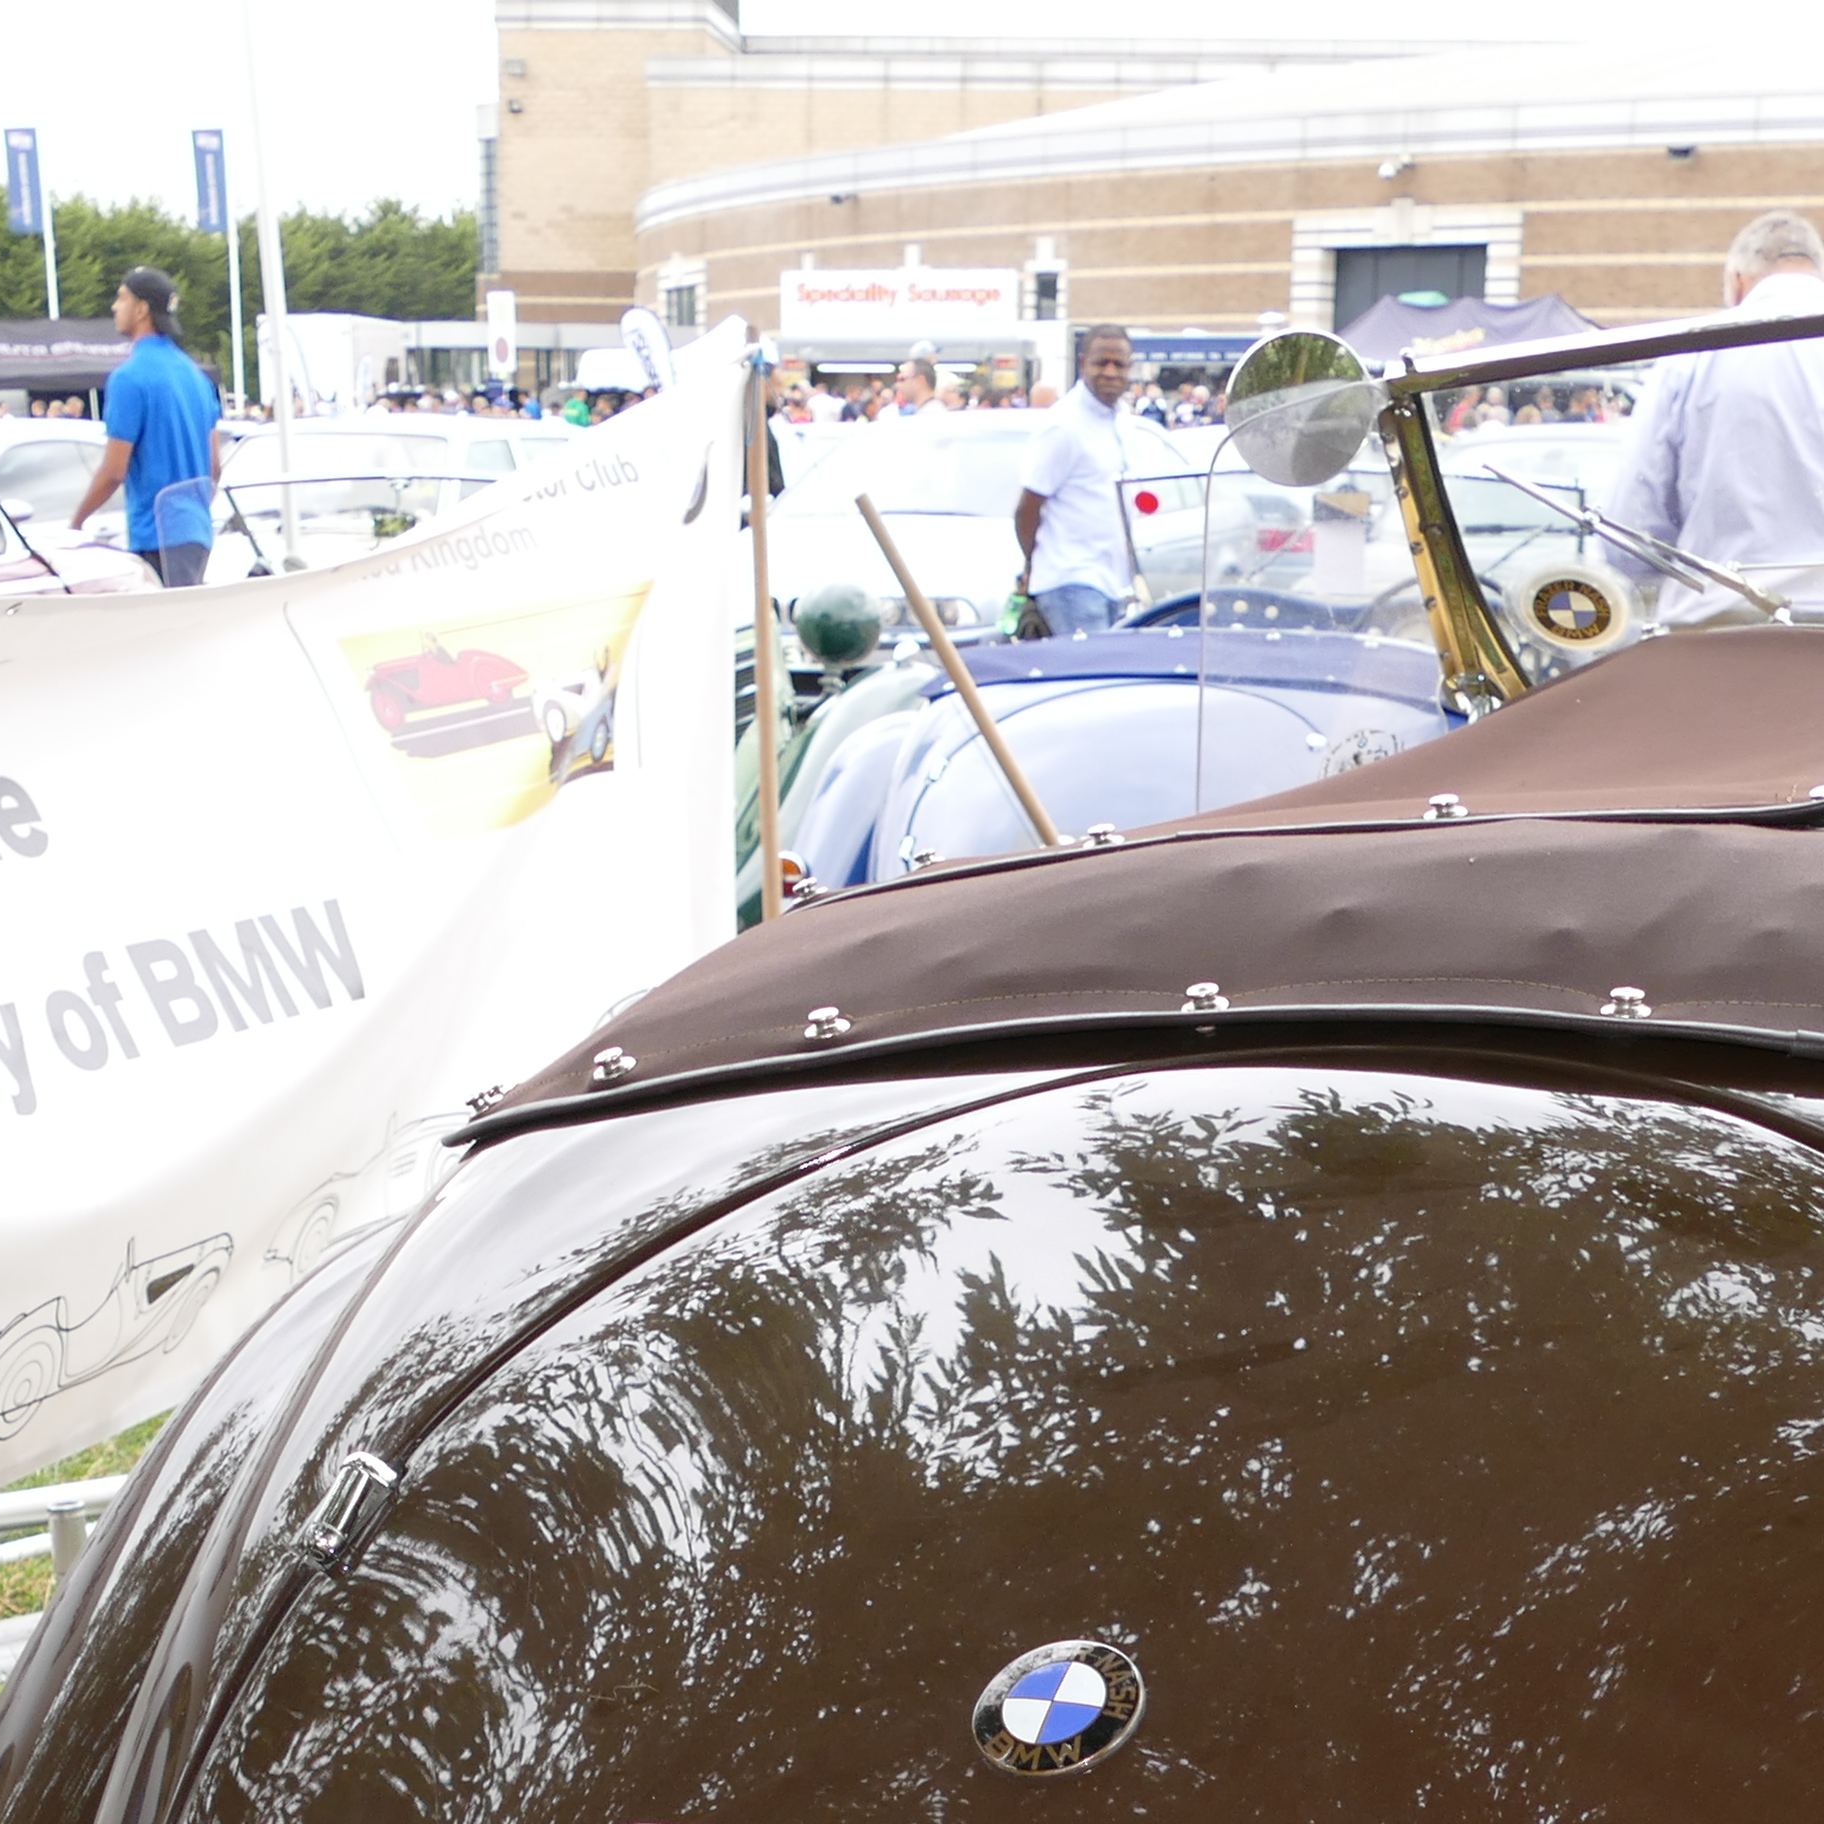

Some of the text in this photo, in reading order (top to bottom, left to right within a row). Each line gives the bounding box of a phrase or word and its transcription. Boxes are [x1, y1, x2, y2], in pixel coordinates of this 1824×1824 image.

[45, 951, 142, 1072] of
[126, 899, 367, 1048] BMW
[1094, 1652, 1138, 1721] NASH
[984, 1730, 1083, 1771] BMW
